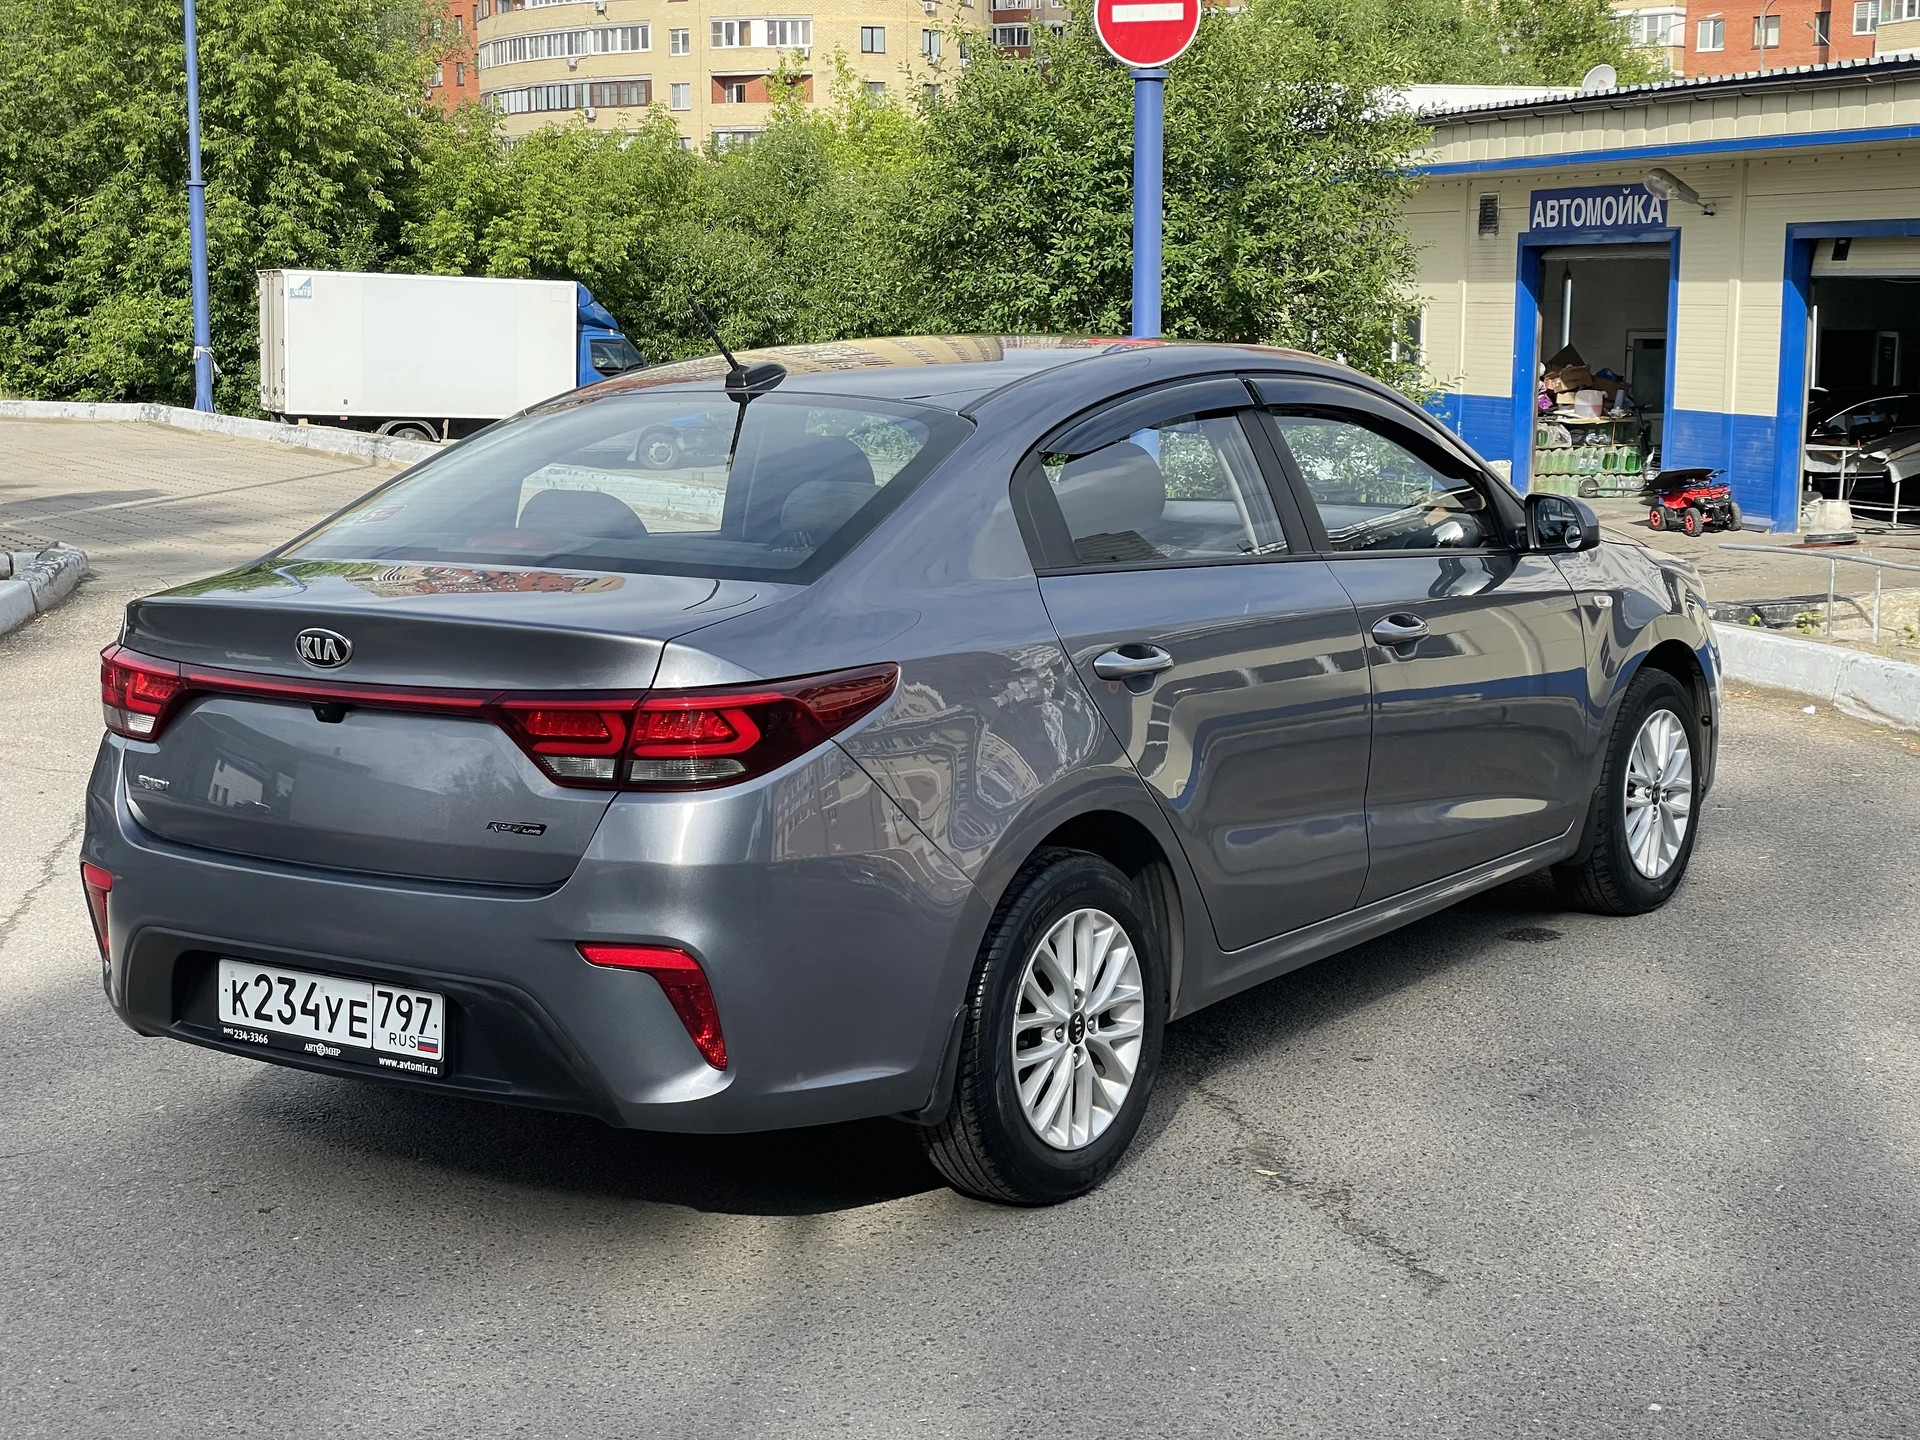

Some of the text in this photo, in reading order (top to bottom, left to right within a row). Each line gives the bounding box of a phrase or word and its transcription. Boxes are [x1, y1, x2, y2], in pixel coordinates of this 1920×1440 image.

[1532, 188, 1664, 229] АВТОМОЙКА
[300, 635, 341, 661] KIA
[231, 973, 433, 1039] К234УЕ 797
[388, 1032, 417, 1049] RUS
[378, 1057, 438, 1075] www.avtomir.ru
